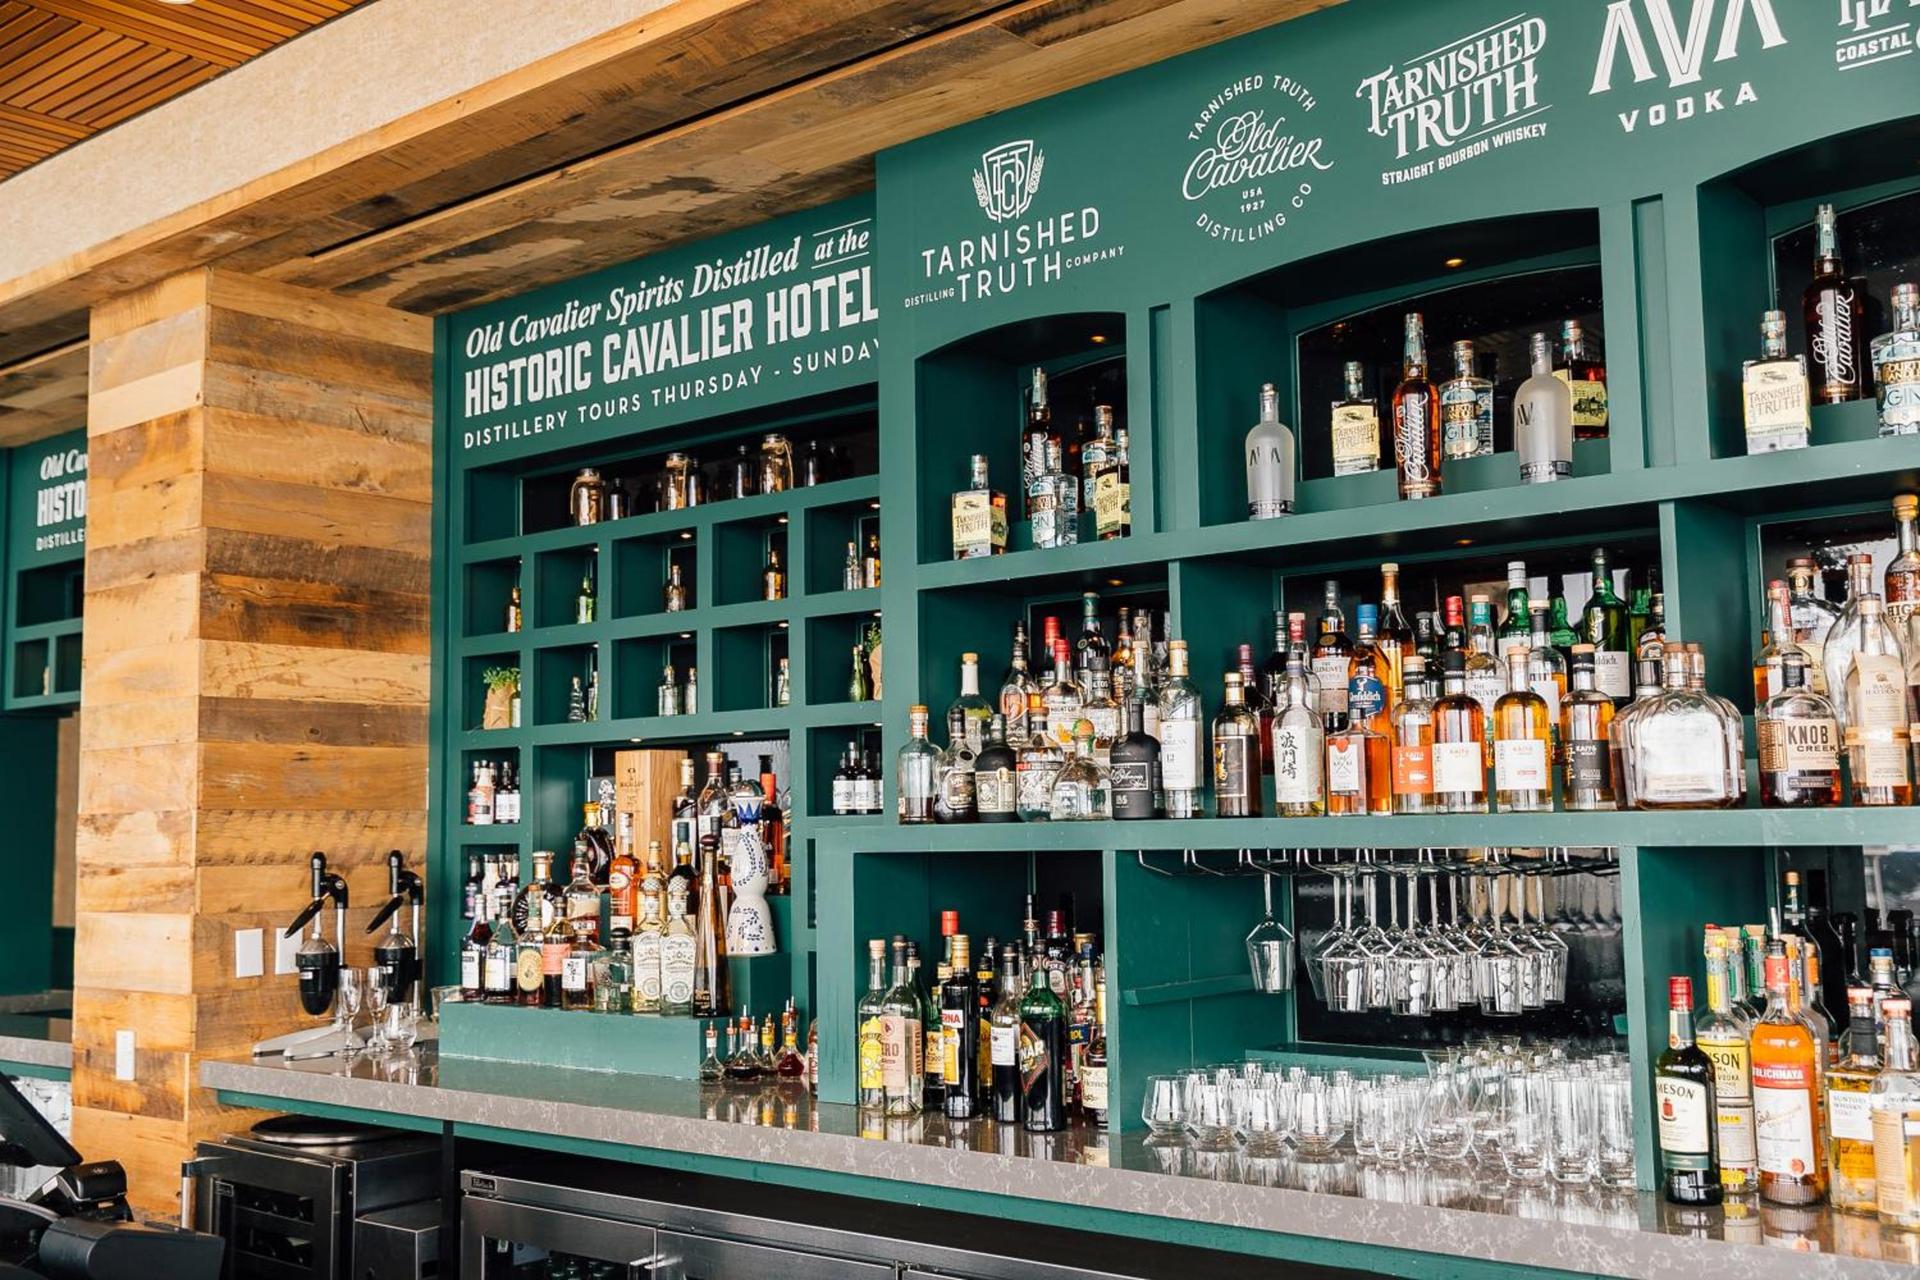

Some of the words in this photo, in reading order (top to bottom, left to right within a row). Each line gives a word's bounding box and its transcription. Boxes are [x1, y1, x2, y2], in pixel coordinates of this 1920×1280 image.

[1355, 17, 1547, 137] TARNISHED
[1836, 32, 1912, 63] COASTAL
[1188, 75, 1263, 141] TARNISHED
[1273, 75, 1316, 112] TRUTH
[1217, 109, 1286, 160] Old
[1388, 57, 1538, 160] TRUTH
[1618, 81, 1758, 133] VODKA
[1182, 135, 1334, 200] Cavalier
[1382, 161, 1434, 185] STRAIGHT
[1438, 139, 1489, 170] BOURBON
[1492, 123, 1547, 148] WHISKEY
[1196, 213, 1286, 242] DISTILLING
[1292, 183, 1312, 208] CO
[1240, 200, 1265, 213] 1927
[1242, 187, 1263, 199] USA
[922, 207, 1099, 277] TARNISHED
[465, 321, 503, 358] Old
[508, 301, 601, 346] Cavalier
[606, 275, 684, 325] Spirits
[690, 236, 800, 299] Distilled
[814, 236, 836, 261] at
[838, 228, 870, 256] the
[904, 287, 955, 308] DISTILLING
[957, 251, 1061, 302] TRUTH
[1065, 245, 1125, 269] COMPANY
[463, 340, 592, 418] HISTORIC
[603, 298, 754, 384] CAVALIER
[767, 265, 879, 346] HOTEL
[463, 410, 568, 449] DISTILLERY
[578, 394, 641, 422] TOURS
[652, 364, 762, 407] THURSDAY
[1754, 395, 1801, 415] TRUTH
[41, 452, 65, 480] Old
[1787, 725, 1829, 745] KNOB
[1709, 1052, 1740, 1070] SON
